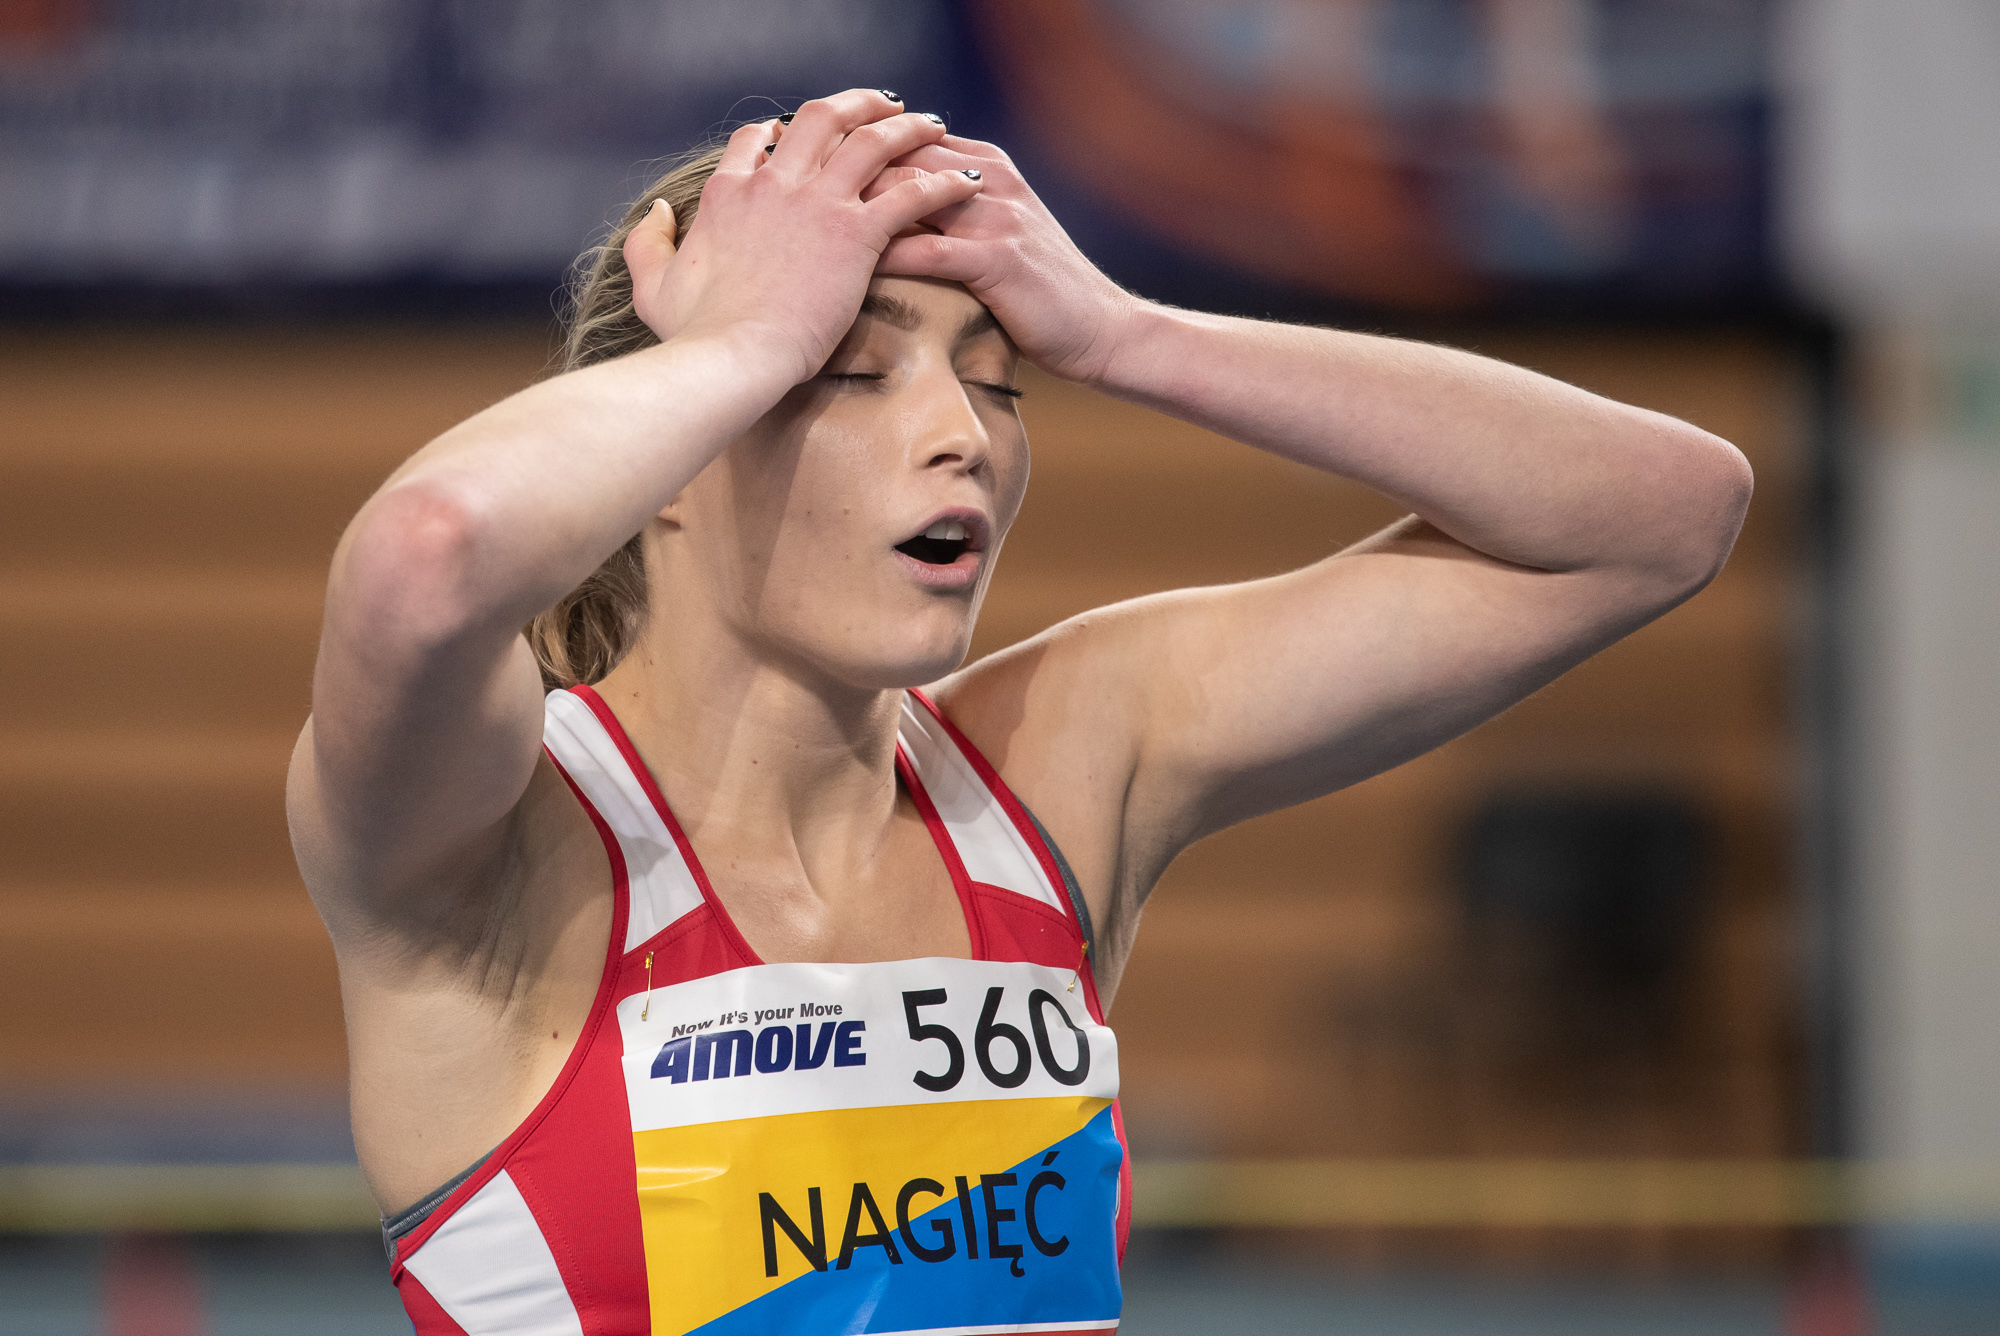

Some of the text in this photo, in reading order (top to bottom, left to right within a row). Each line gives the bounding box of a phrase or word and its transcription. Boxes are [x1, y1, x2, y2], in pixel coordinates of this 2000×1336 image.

[671, 1003, 843, 1038] Now It's your Move
[901, 987, 1091, 1092] 560
[758, 1151, 1070, 1278] NAGIĘĆ
